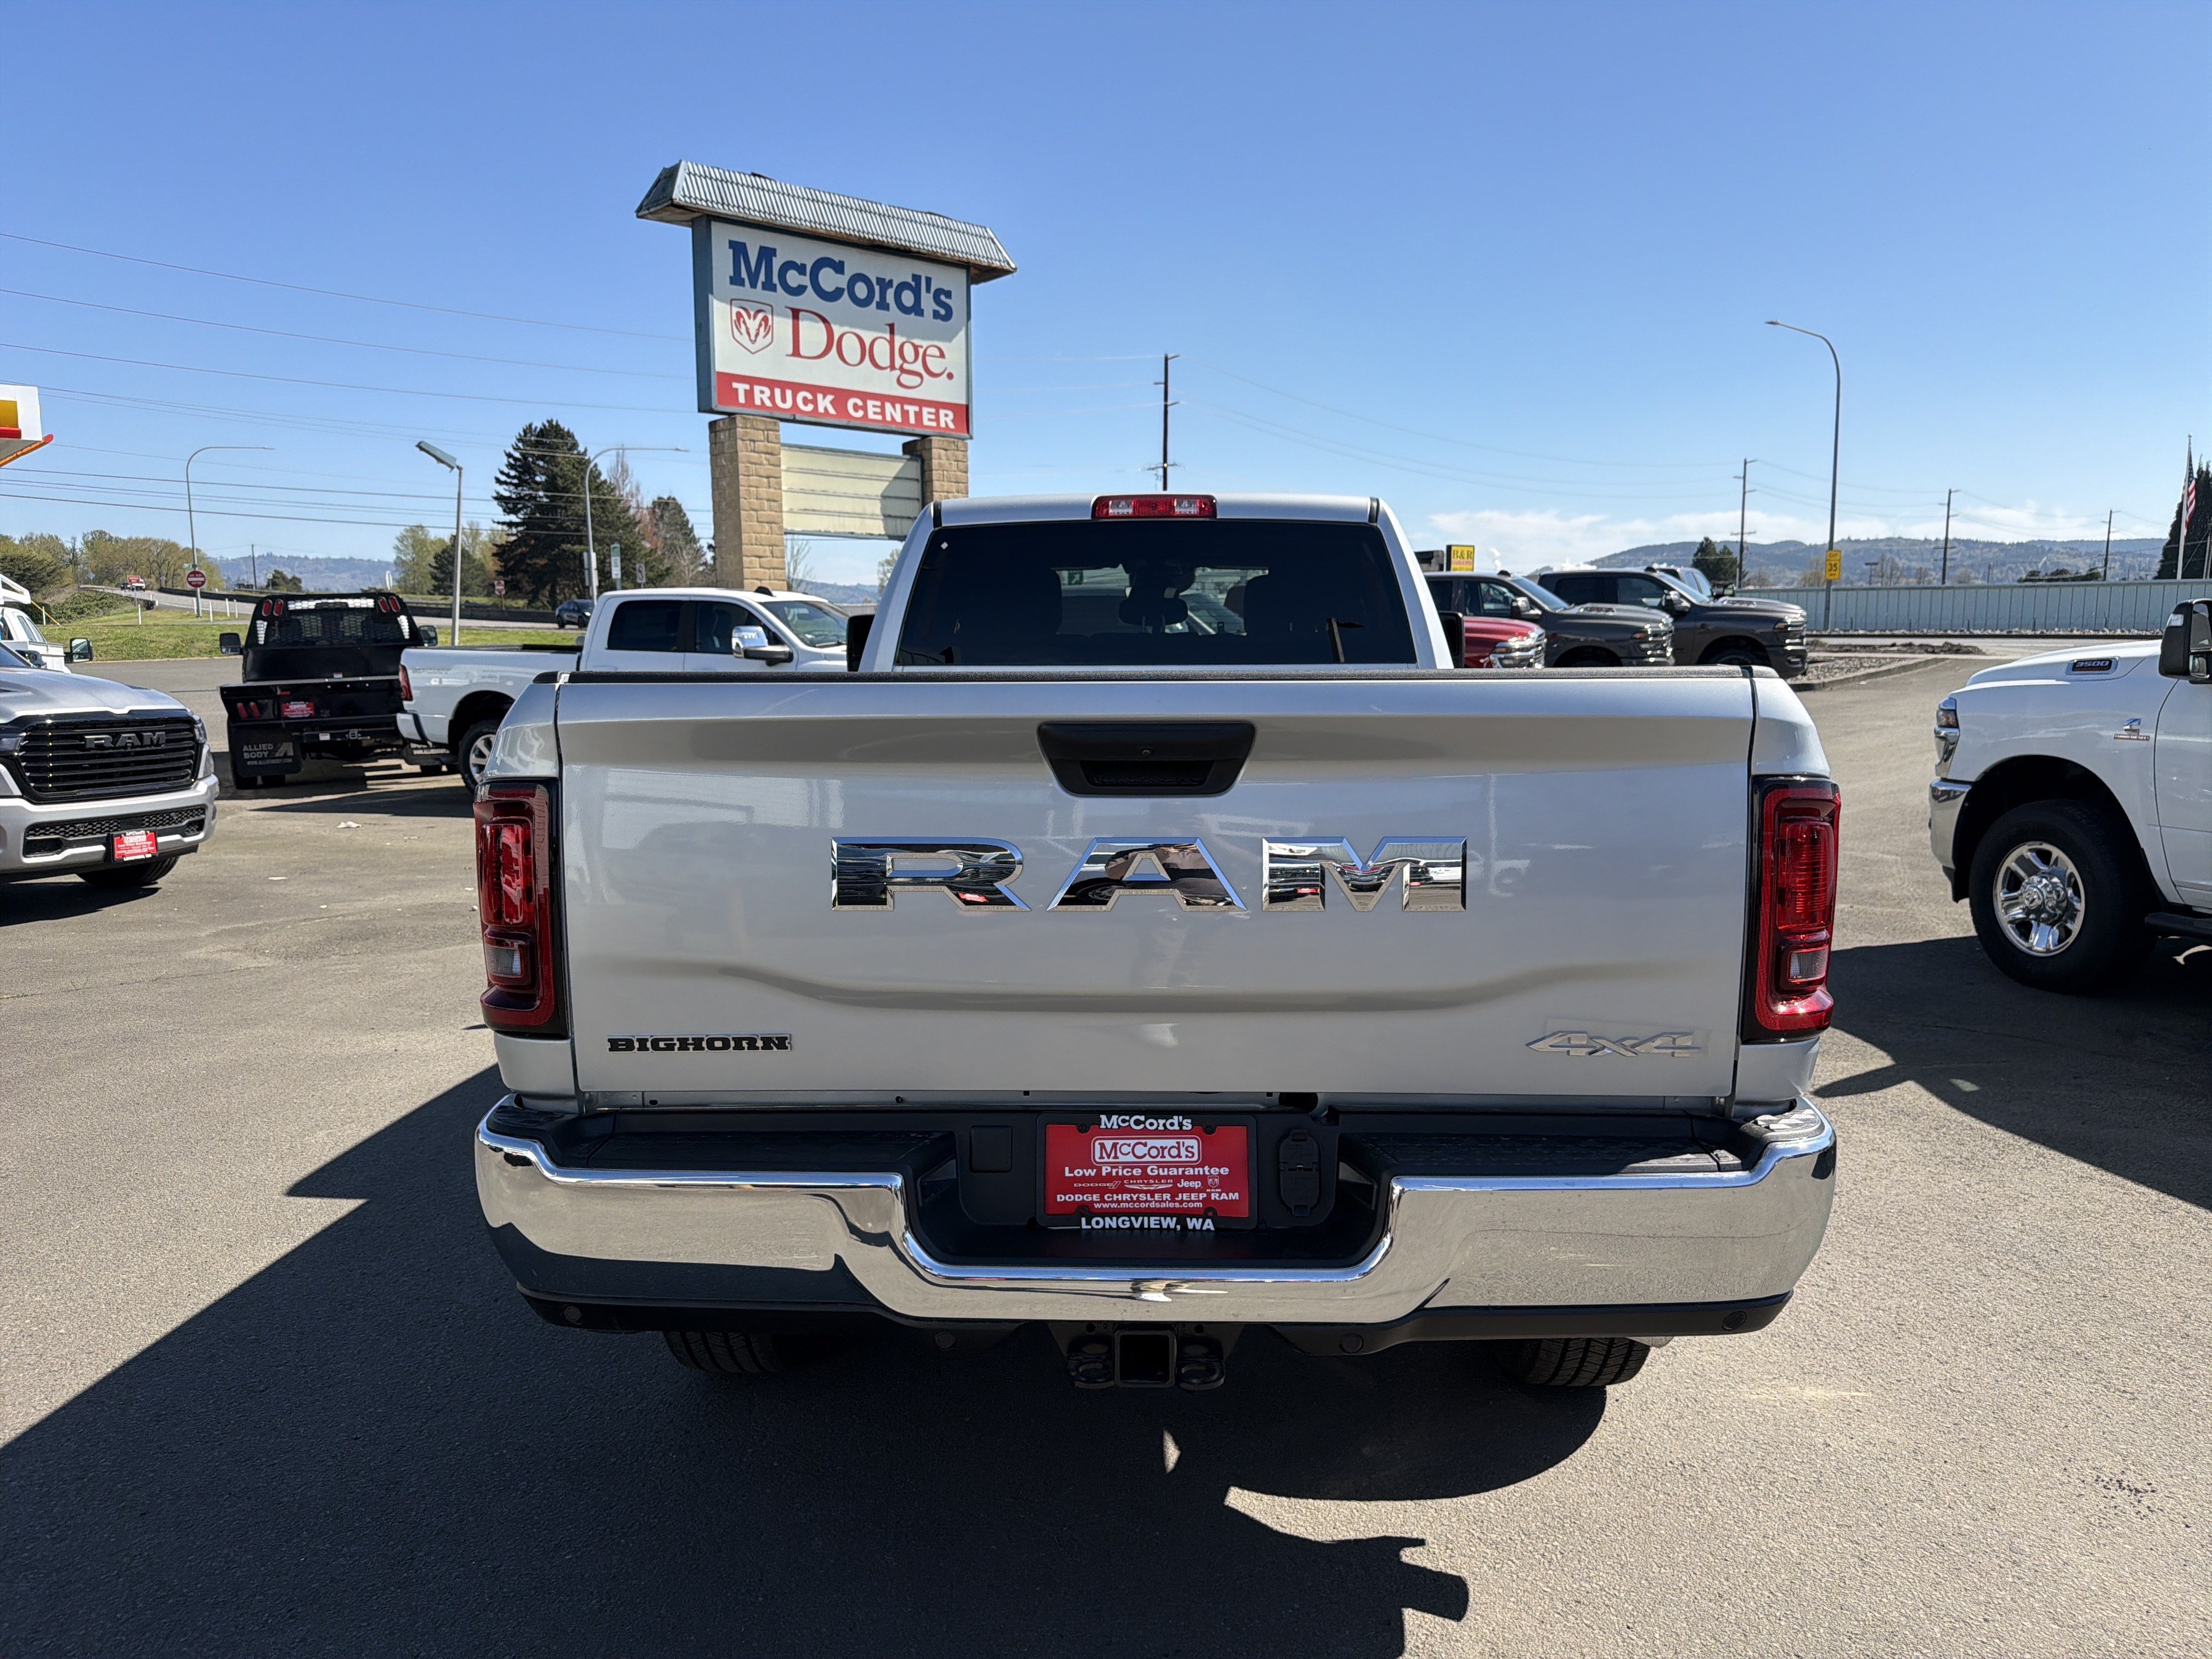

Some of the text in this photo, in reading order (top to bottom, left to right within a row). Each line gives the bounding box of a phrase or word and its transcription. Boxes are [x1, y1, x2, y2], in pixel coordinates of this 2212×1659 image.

[728, 240, 953, 322] McCord's
[732, 382, 955, 430] TRUCK CENTER
[1827, 562, 1838, 572] 35
[84, 732, 166, 748] RAM
[243, 743, 274, 752] ALLIED
[243, 751, 269, 759] BODY
[831, 836, 1467, 912] RAM
[607, 1034, 790, 1053] BIGHORN
[1525, 1031, 1701, 1057] 4x4
[1099, 1114, 1192, 1130] McCord's
[1098, 1141, 1195, 1160] McCord's
[1065, 1165, 1229, 1177] Low Price Guarantee
[1177, 1178, 1201, 1189] Jeep
[1081, 1217, 1215, 1231] LONGVIEW, WA
